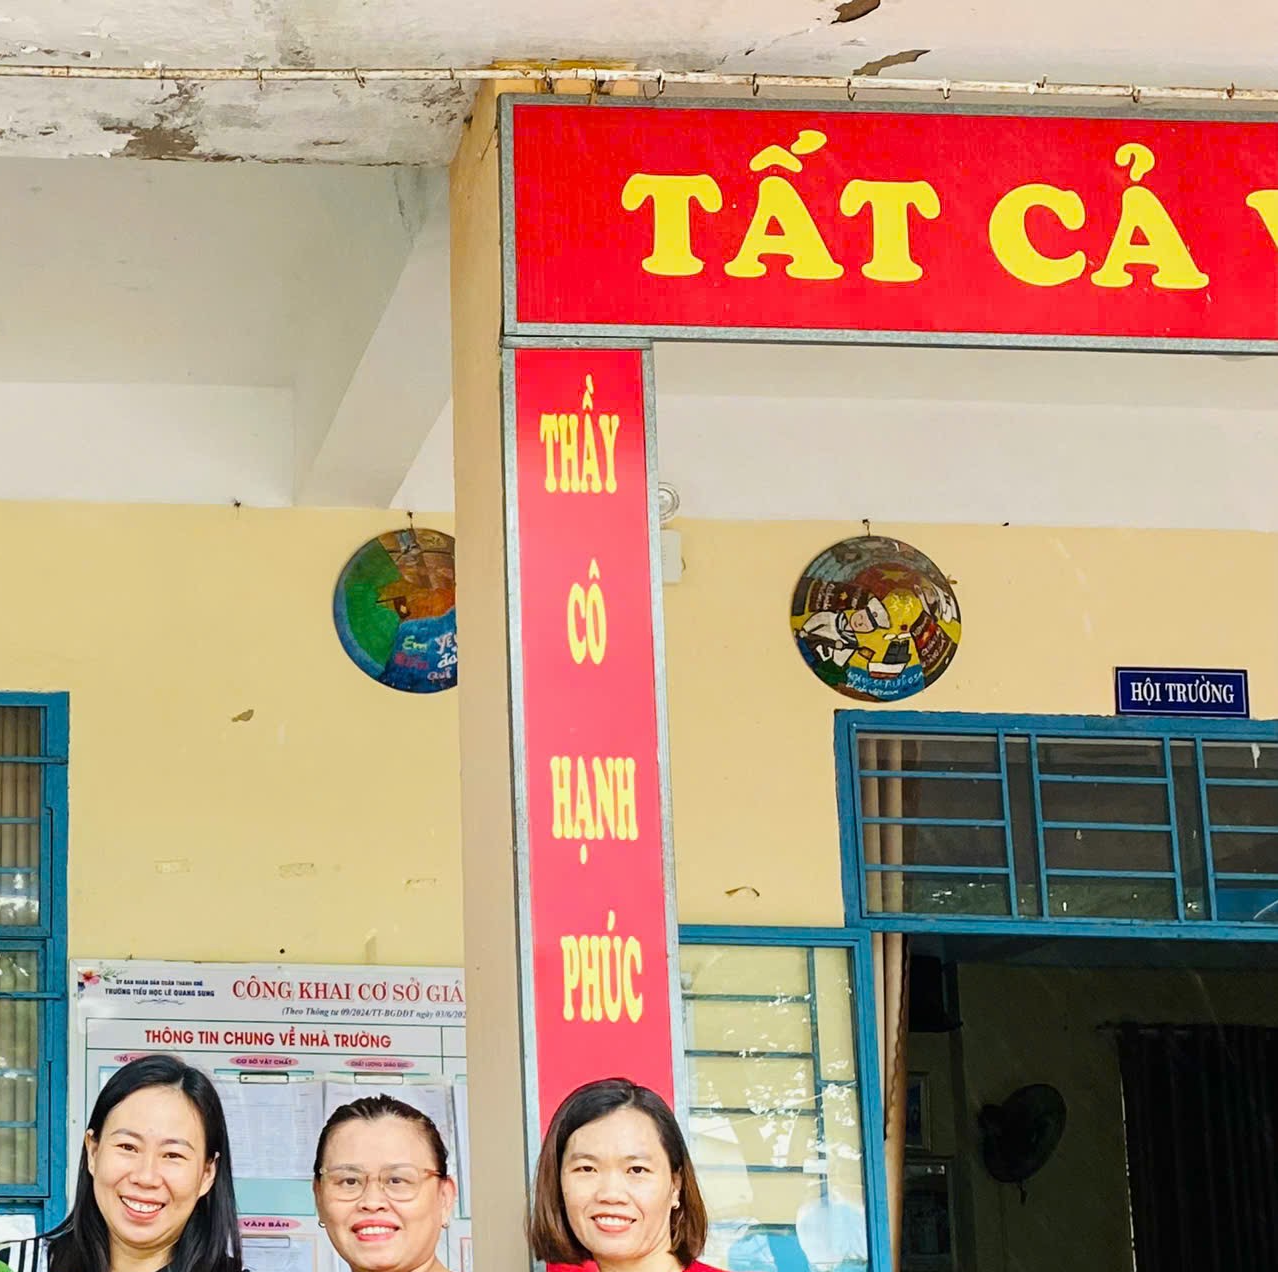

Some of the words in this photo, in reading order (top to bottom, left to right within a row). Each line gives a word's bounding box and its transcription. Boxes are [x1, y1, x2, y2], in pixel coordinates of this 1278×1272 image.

[621, 130, 941, 283] TẤT
[988, 143, 1210, 290] CẢ
[540, 373, 620, 494] THẦY
[567, 557, 607, 665] CÔ
[1130, 677, 1161, 706] HỘI
[1165, 675, 1234, 704] TRƯỜNG
[550, 755, 639, 865] HẠNH
[233, 975, 292, 999] CÔNG
[298, 981, 353, 1000] KHAI
[358, 982, 387, 1001] CƠ
[393, 977, 420, 1002] SỞ
[561, 910, 643, 1024] PHÚC
[145, 1026, 194, 1044] THÔNG
[198, 1030, 219, 1044] TIN
[223, 1031, 275, 1046] CHUNG
[279, 1025, 296, 1046] VỀ
[300, 1030, 330, 1047] NHÀ
[334, 1030, 391, 1048] TRƯỜNG
